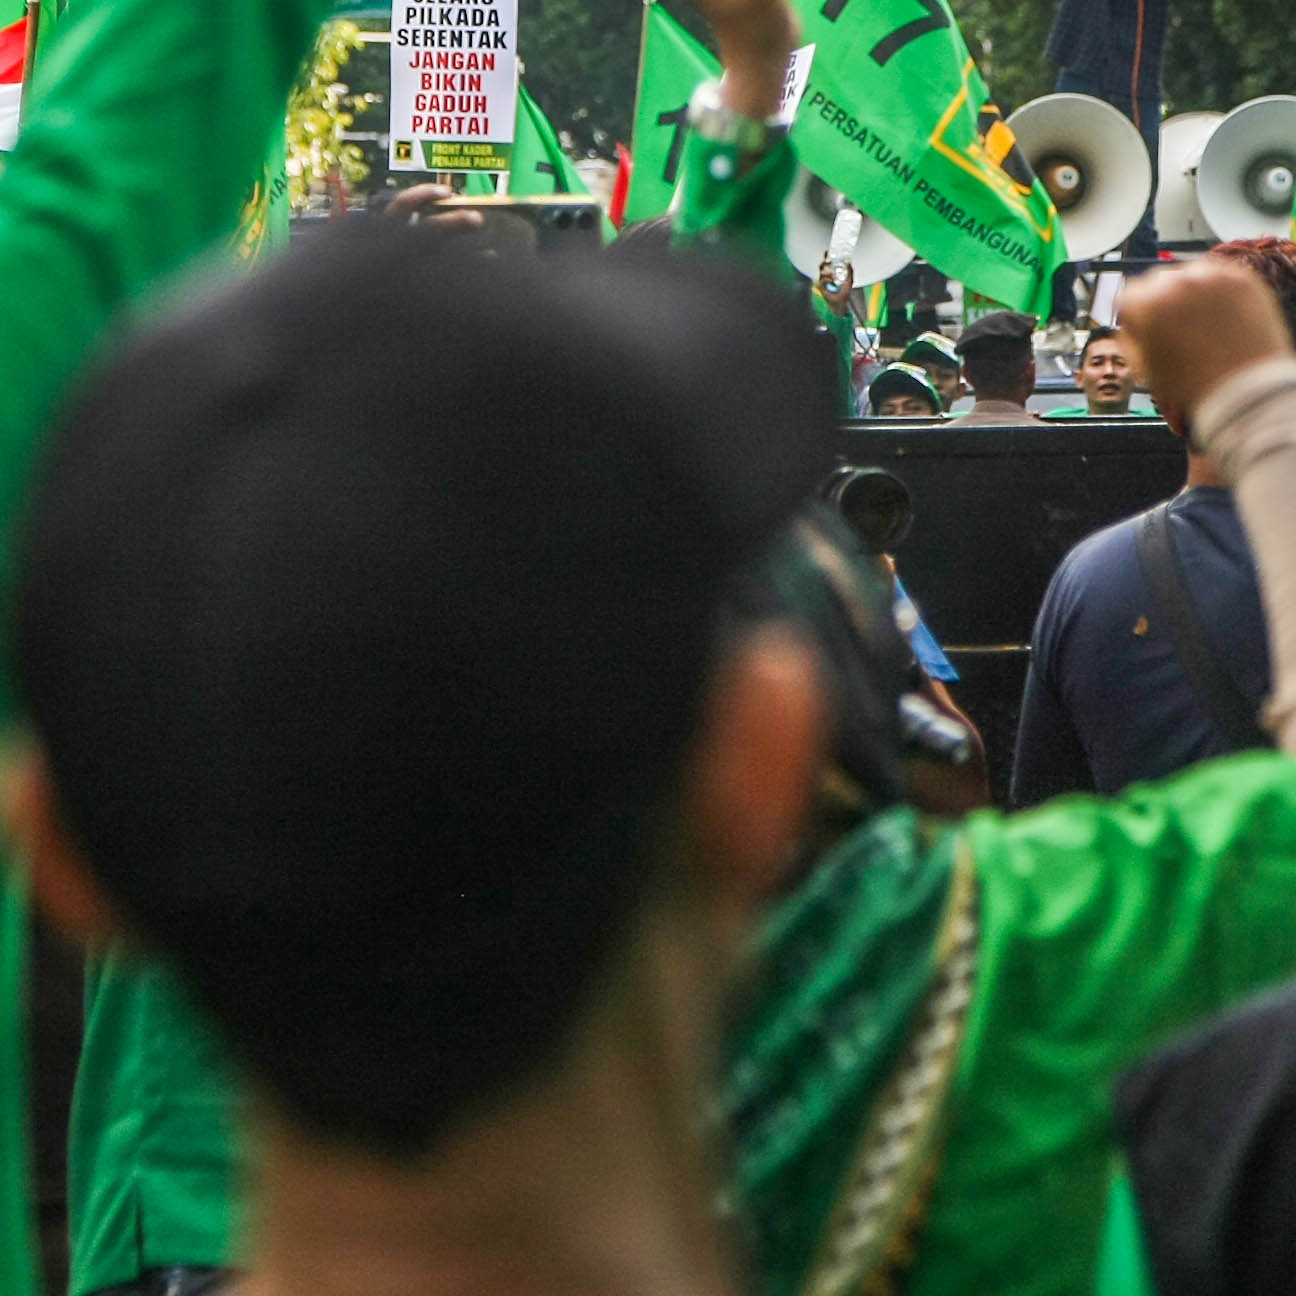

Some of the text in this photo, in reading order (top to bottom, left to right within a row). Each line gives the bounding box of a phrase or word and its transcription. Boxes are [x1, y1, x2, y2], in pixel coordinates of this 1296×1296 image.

[406, 7, 500, 28] PILKADA
[397, 29, 509, 50] SERENTAK
[409, 51, 496, 72] JANGAN
[421, 72, 482, 93] BIKIN
[415, 94, 488, 114] GADUH
[412, 115, 490, 136] PARTAI
[807, 90, 1043, 272] PERSATUAN PEMBANGUNA
